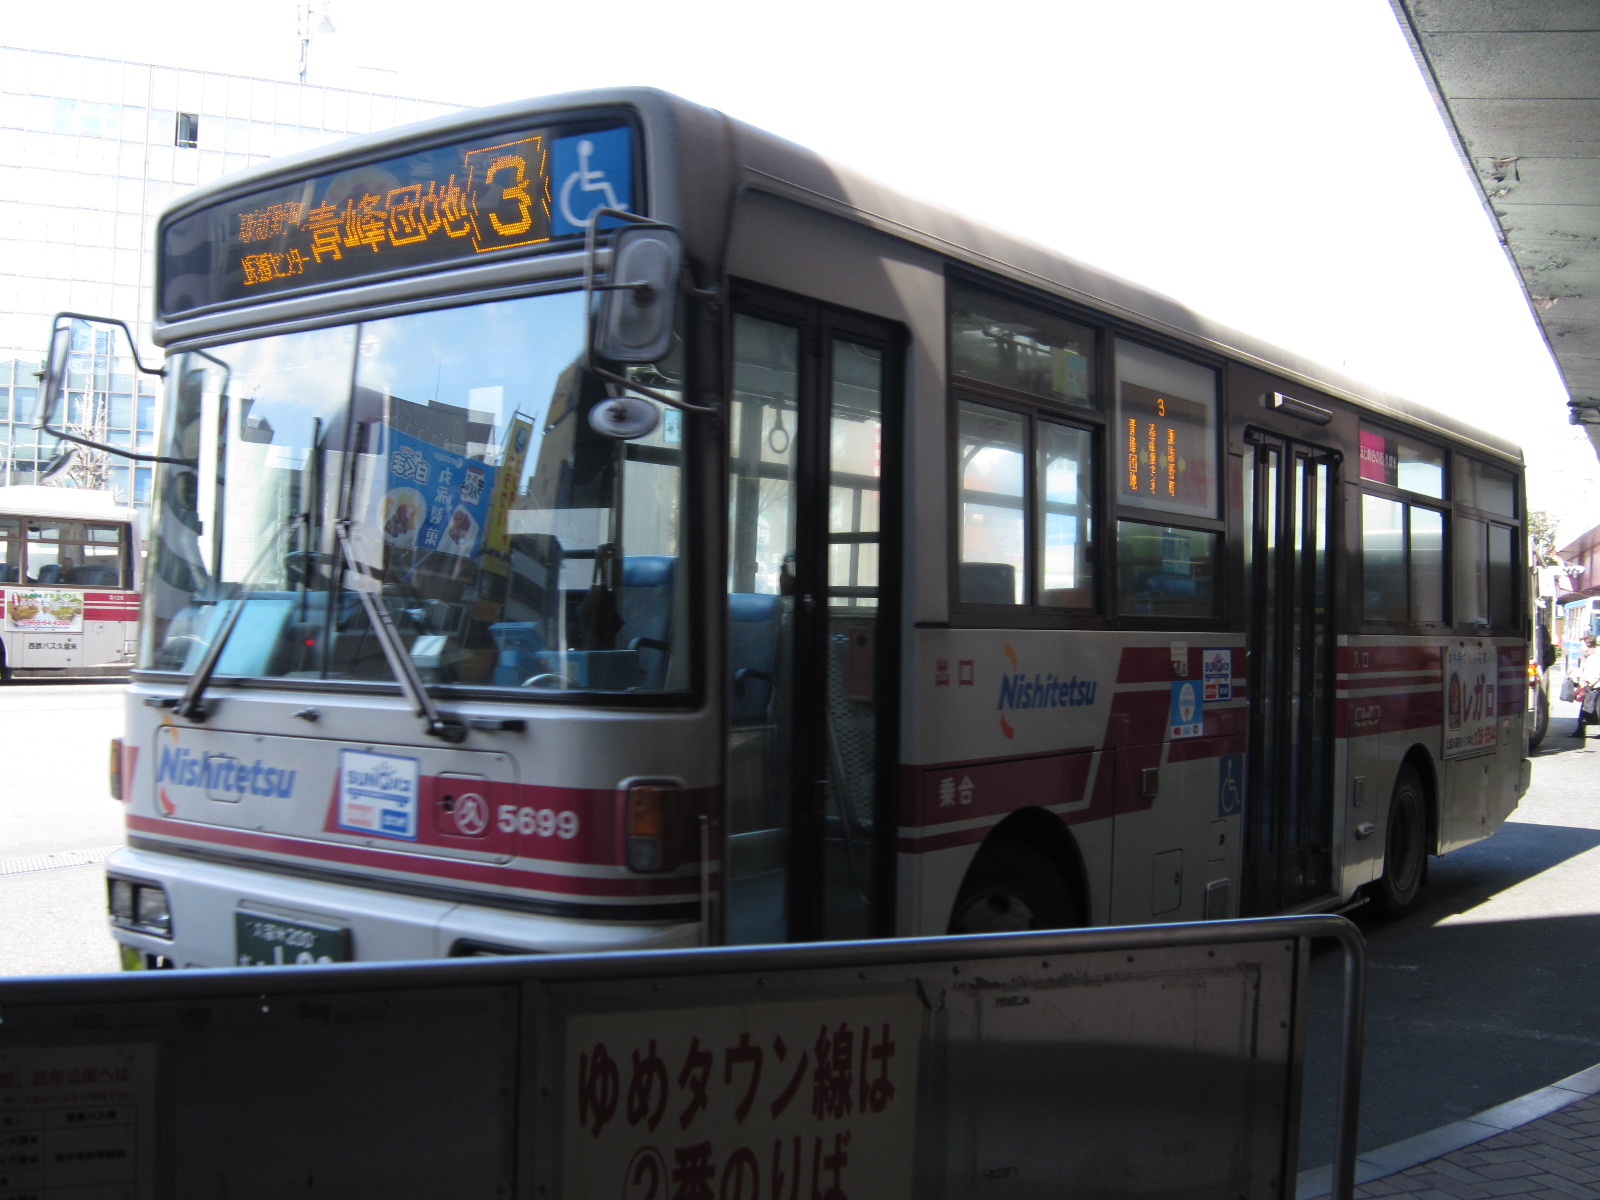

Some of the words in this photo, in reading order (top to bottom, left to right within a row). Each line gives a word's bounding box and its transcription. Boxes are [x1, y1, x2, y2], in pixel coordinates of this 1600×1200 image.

[484, 154, 532, 237] 3
[304, 174, 471, 263] 青峰団地
[1157, 398, 1166, 417] 3
[28, 642, 78, 650] 西鉄バス久留米
[1353, 651, 1369, 669] 入口
[935, 659, 975, 687] 出口
[997, 672, 1098, 711] Nishitetsu
[156, 744, 298, 799] Nishitetsu
[939, 775, 975, 808] 乗合
[497, 804, 580, 840] 5699
[579, 1022, 896, 1139] ゆめタウン線は
